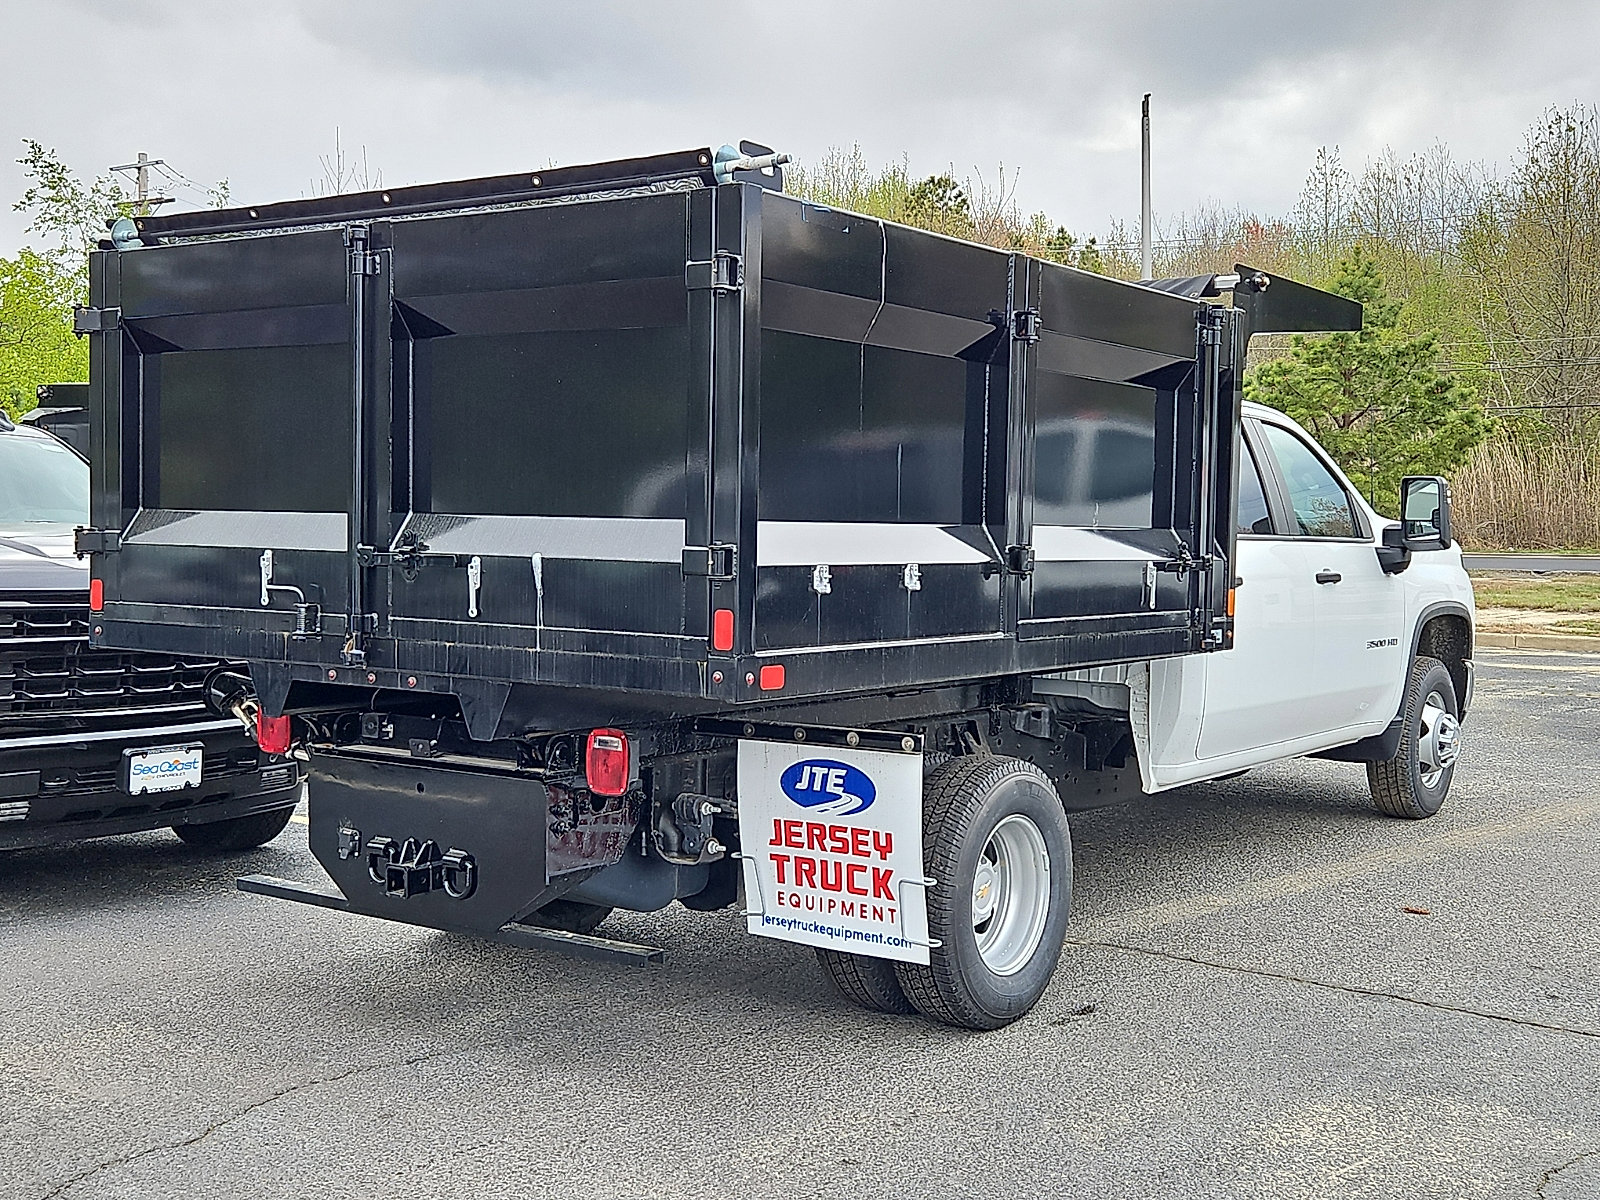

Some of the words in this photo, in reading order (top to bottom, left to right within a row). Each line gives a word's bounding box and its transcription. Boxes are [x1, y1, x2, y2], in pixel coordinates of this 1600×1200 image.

[1366, 640, 1386, 649] 3500
[1387, 638, 1398, 646] HD
[795, 765, 847, 794] JTE
[768, 818, 893, 860] JERSEY
[769, 853, 896, 901] TRUCK
[777, 891, 897, 924] EQUIPMENT
[761, 914, 913, 949] jerseytruckequipment.com
